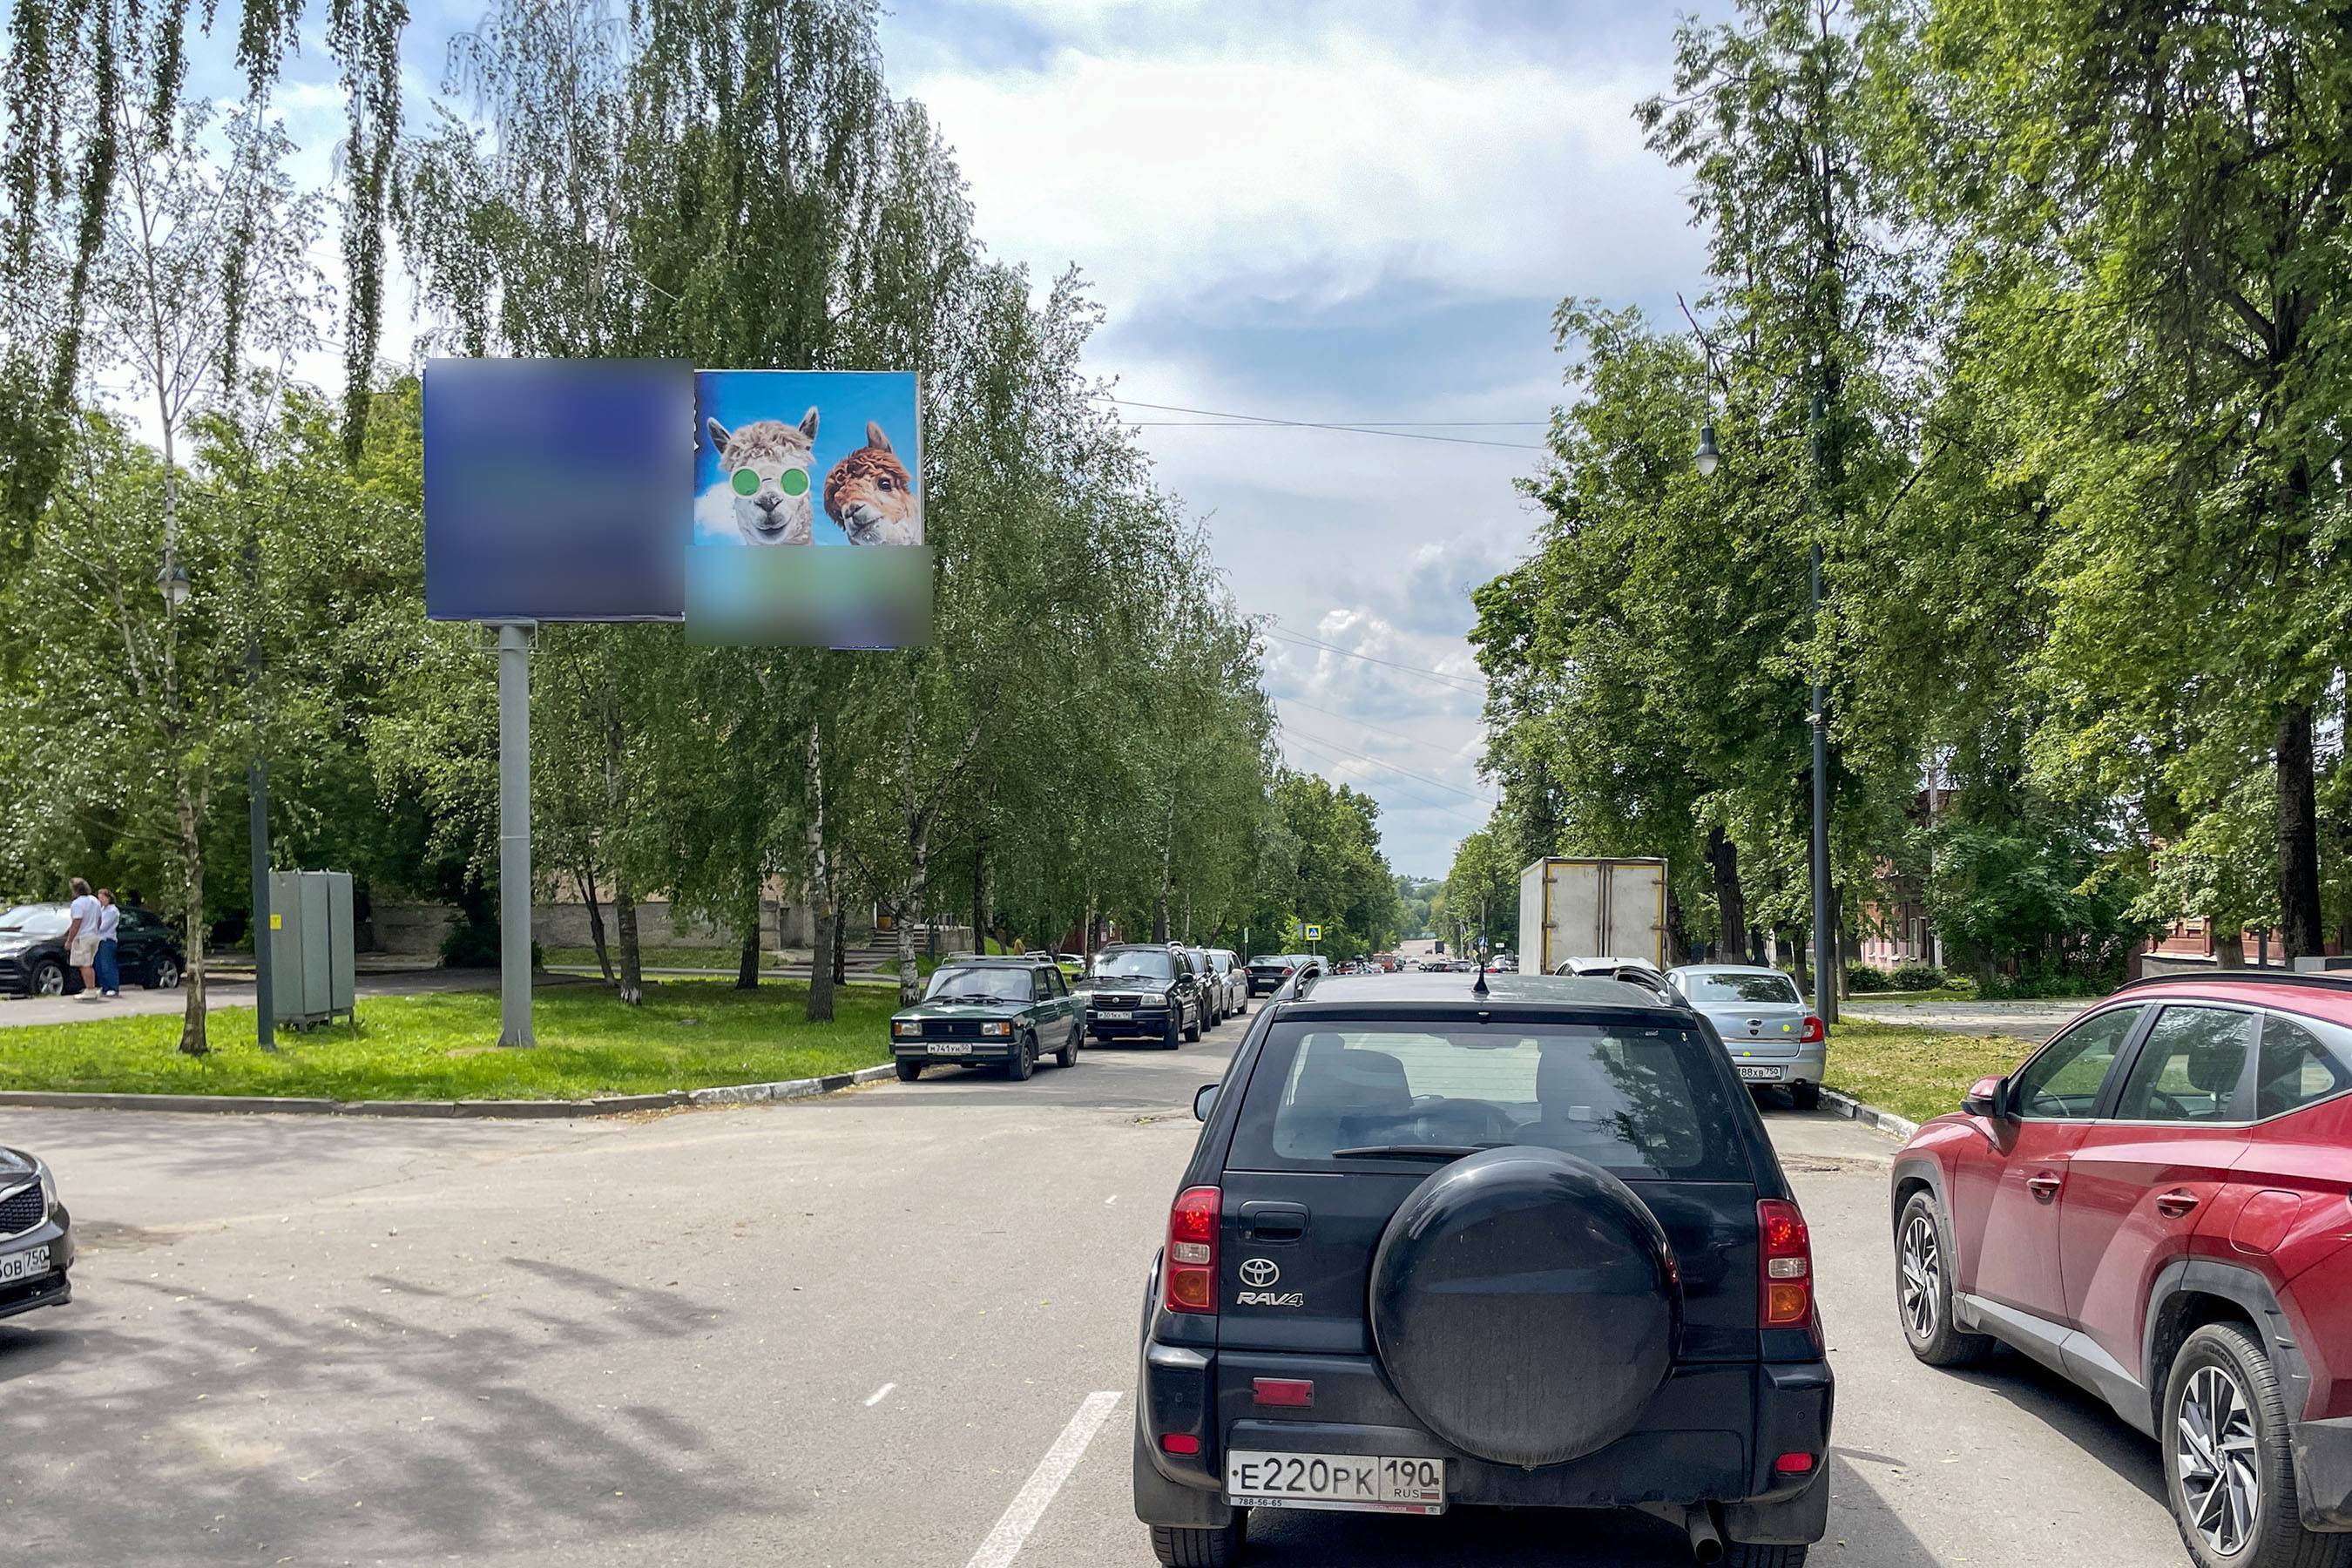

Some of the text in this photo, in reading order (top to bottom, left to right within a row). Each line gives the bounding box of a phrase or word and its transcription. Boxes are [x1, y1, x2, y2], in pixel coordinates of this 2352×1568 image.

[0, 1260, 23, 1278] ОВ
[25, 1249, 46, 1267] 750
[1236, 1292, 1304, 1307] RAV4
[1241, 1457, 1434, 1495] Е220РК 190
[1394, 1489, 1419, 1498] RUS
[1239, 1497, 1282, 1507] 788-56-65
